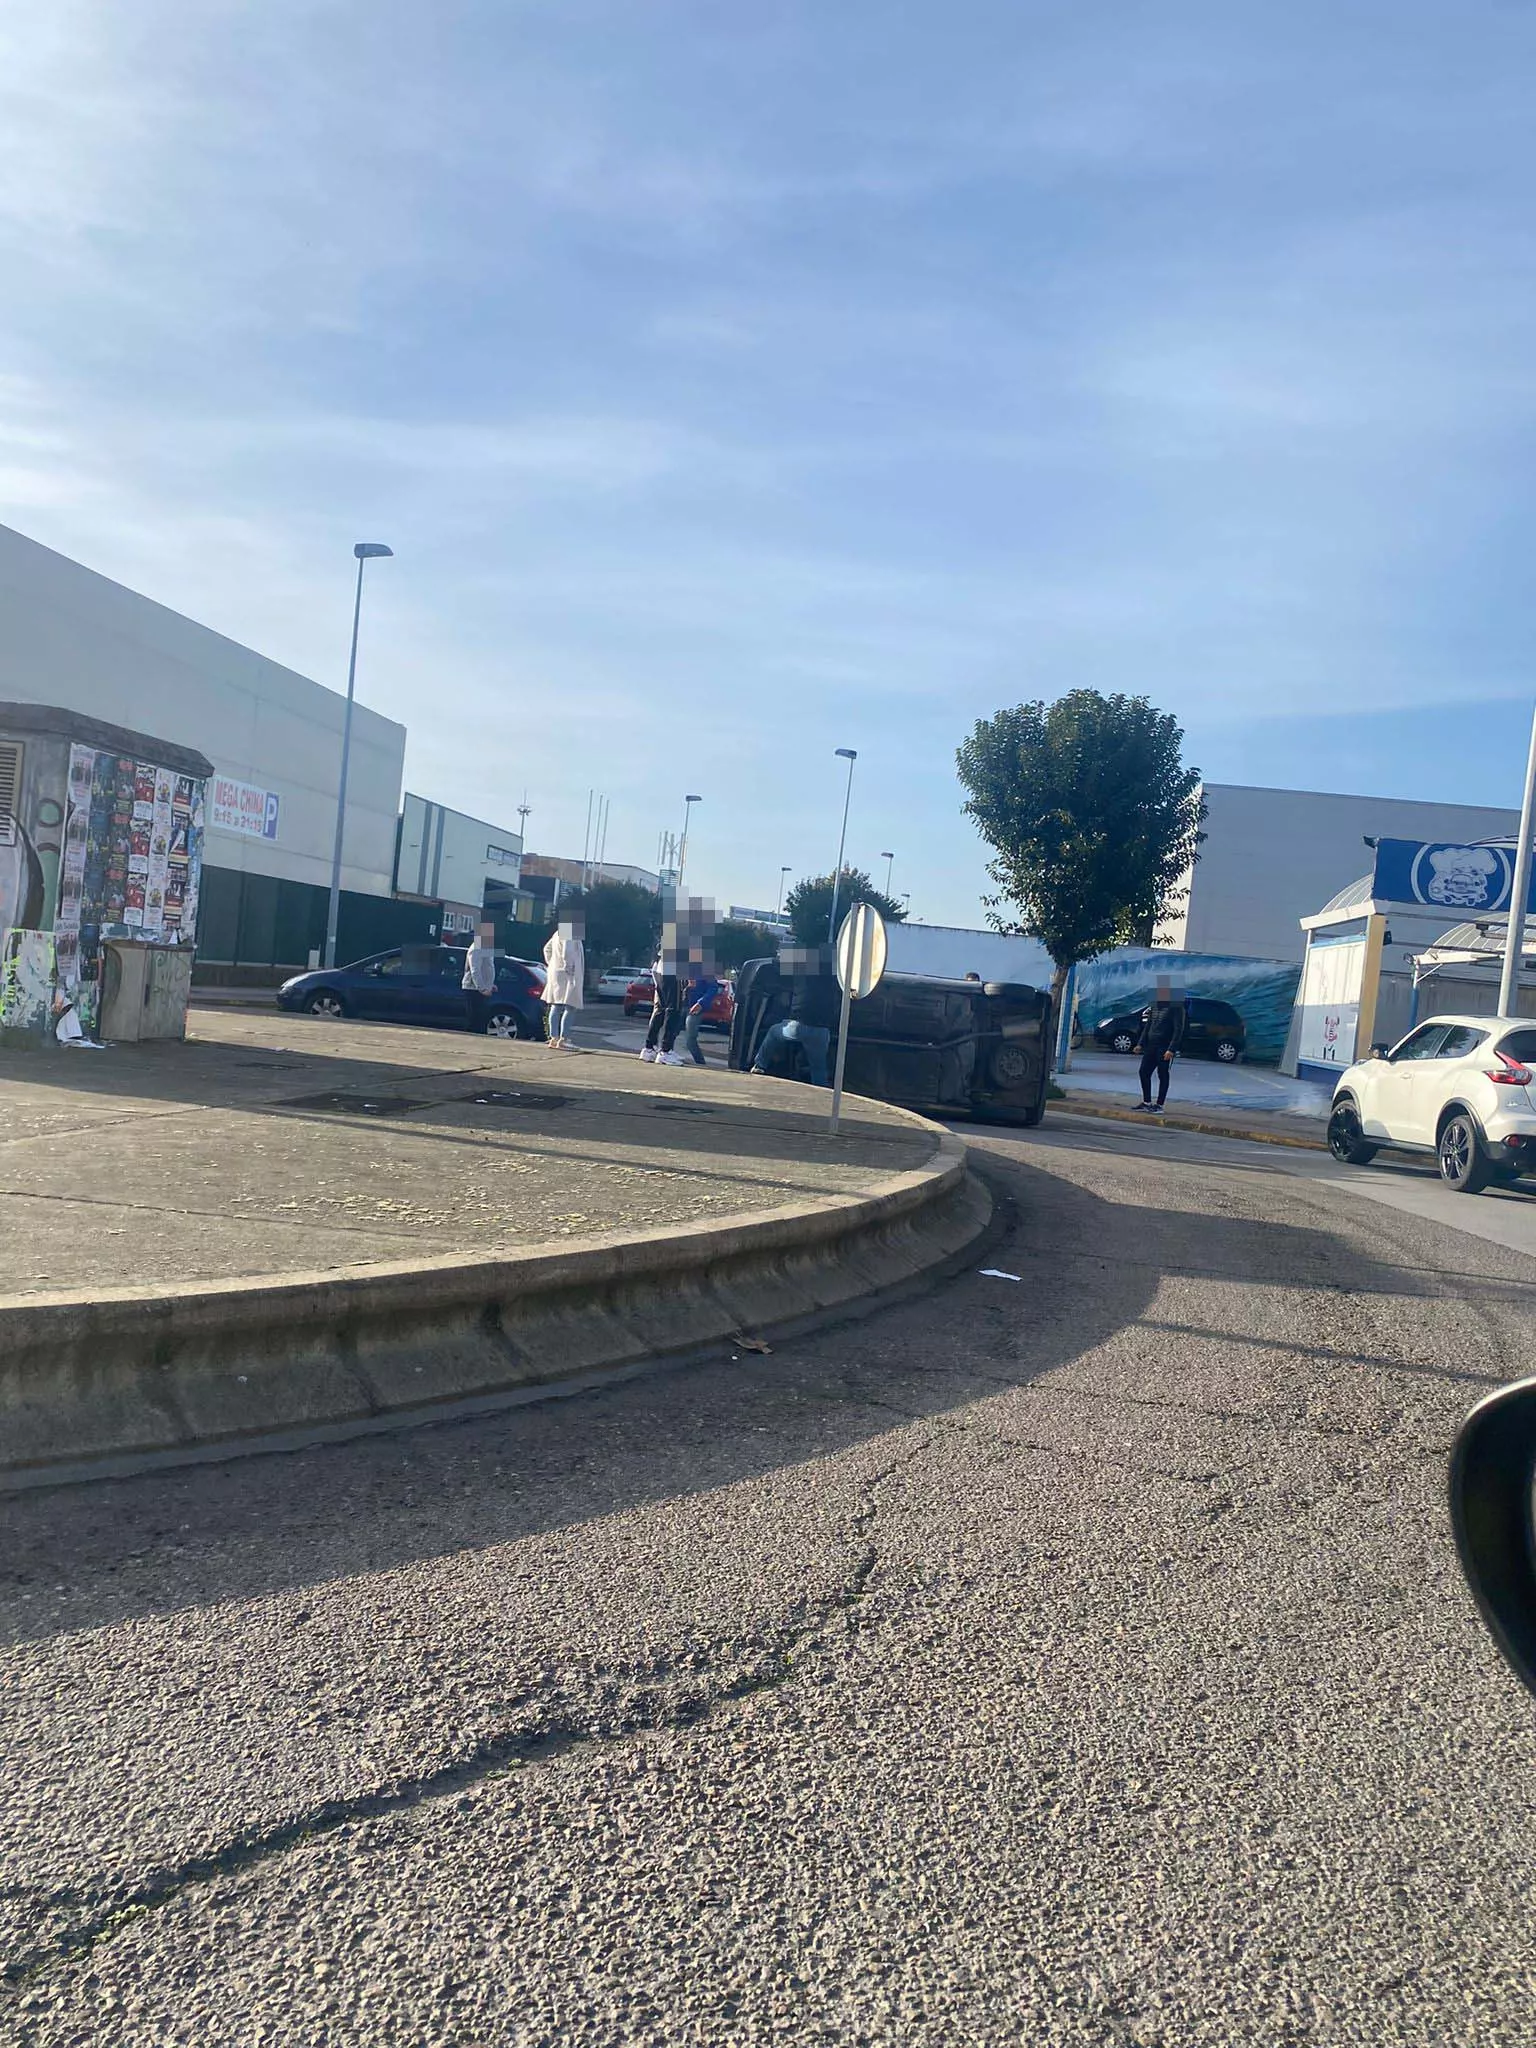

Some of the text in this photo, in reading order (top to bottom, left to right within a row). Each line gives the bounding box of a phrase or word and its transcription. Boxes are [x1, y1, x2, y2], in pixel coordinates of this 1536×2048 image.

[215, 780, 238, 808] MEGA
[240, 789, 263, 814] CHINA
[264, 796, 278, 833] P
